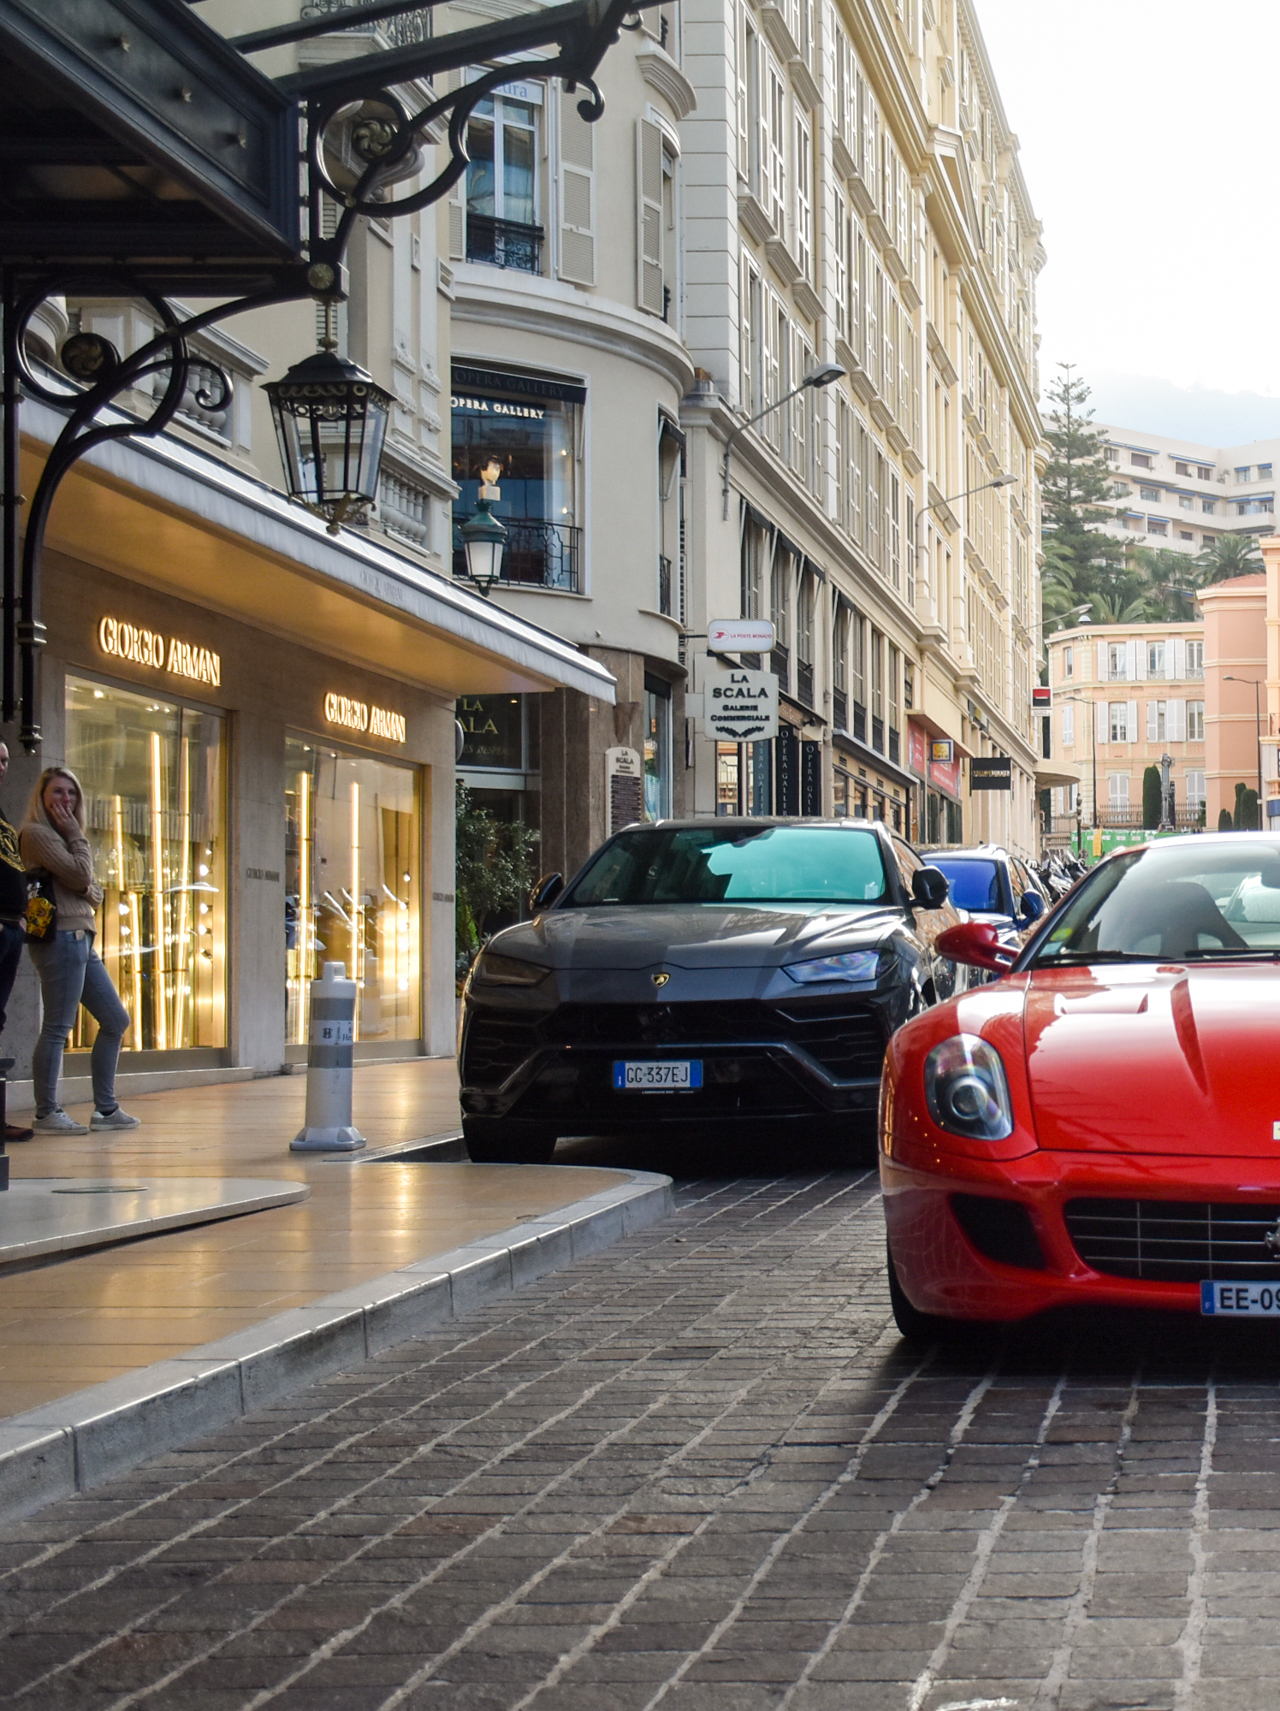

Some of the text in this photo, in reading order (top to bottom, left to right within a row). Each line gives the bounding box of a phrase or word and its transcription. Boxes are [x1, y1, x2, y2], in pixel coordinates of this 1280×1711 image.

[455, 370, 566, 397] OPERA GALLERY
[450, 396, 545, 419] OPERA GALLERY
[98, 616, 221, 687] GIORGIO ARMANI
[730, 673, 749, 684] LA
[463, 698, 483, 711] LA
[712, 687, 769, 698] SCALA
[324, 691, 406, 744] GIORGIO ARMANI
[781, 730, 789, 769] OPERA
[806, 745, 814, 782] OPERA
[1205, 1301, 1211, 1309] F
